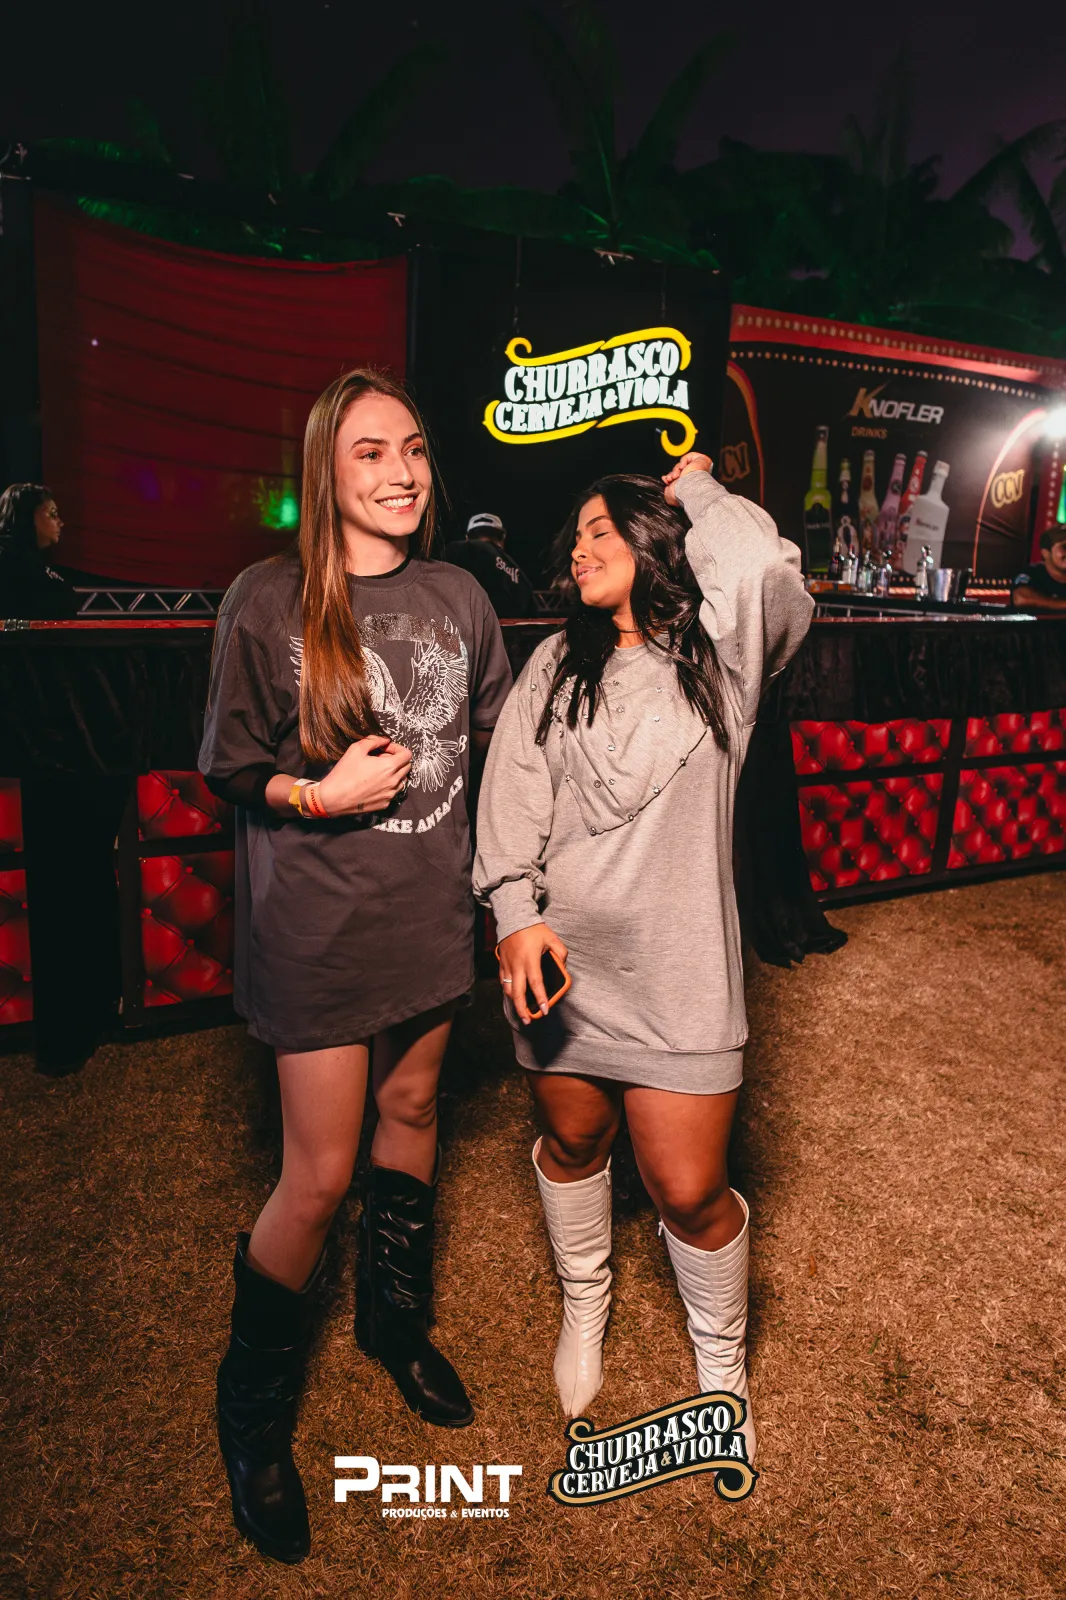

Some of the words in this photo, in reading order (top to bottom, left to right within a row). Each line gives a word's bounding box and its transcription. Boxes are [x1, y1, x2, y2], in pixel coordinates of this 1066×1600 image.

[504, 340, 680, 402] CHURRASCO
[495, 388, 604, 432] CERVEJA
[603, 388, 619, 410] &
[616, 376, 690, 411] VIOLA
[847, 385, 945, 424] KNOFLER
[851, 425, 888, 439] DRINKS
